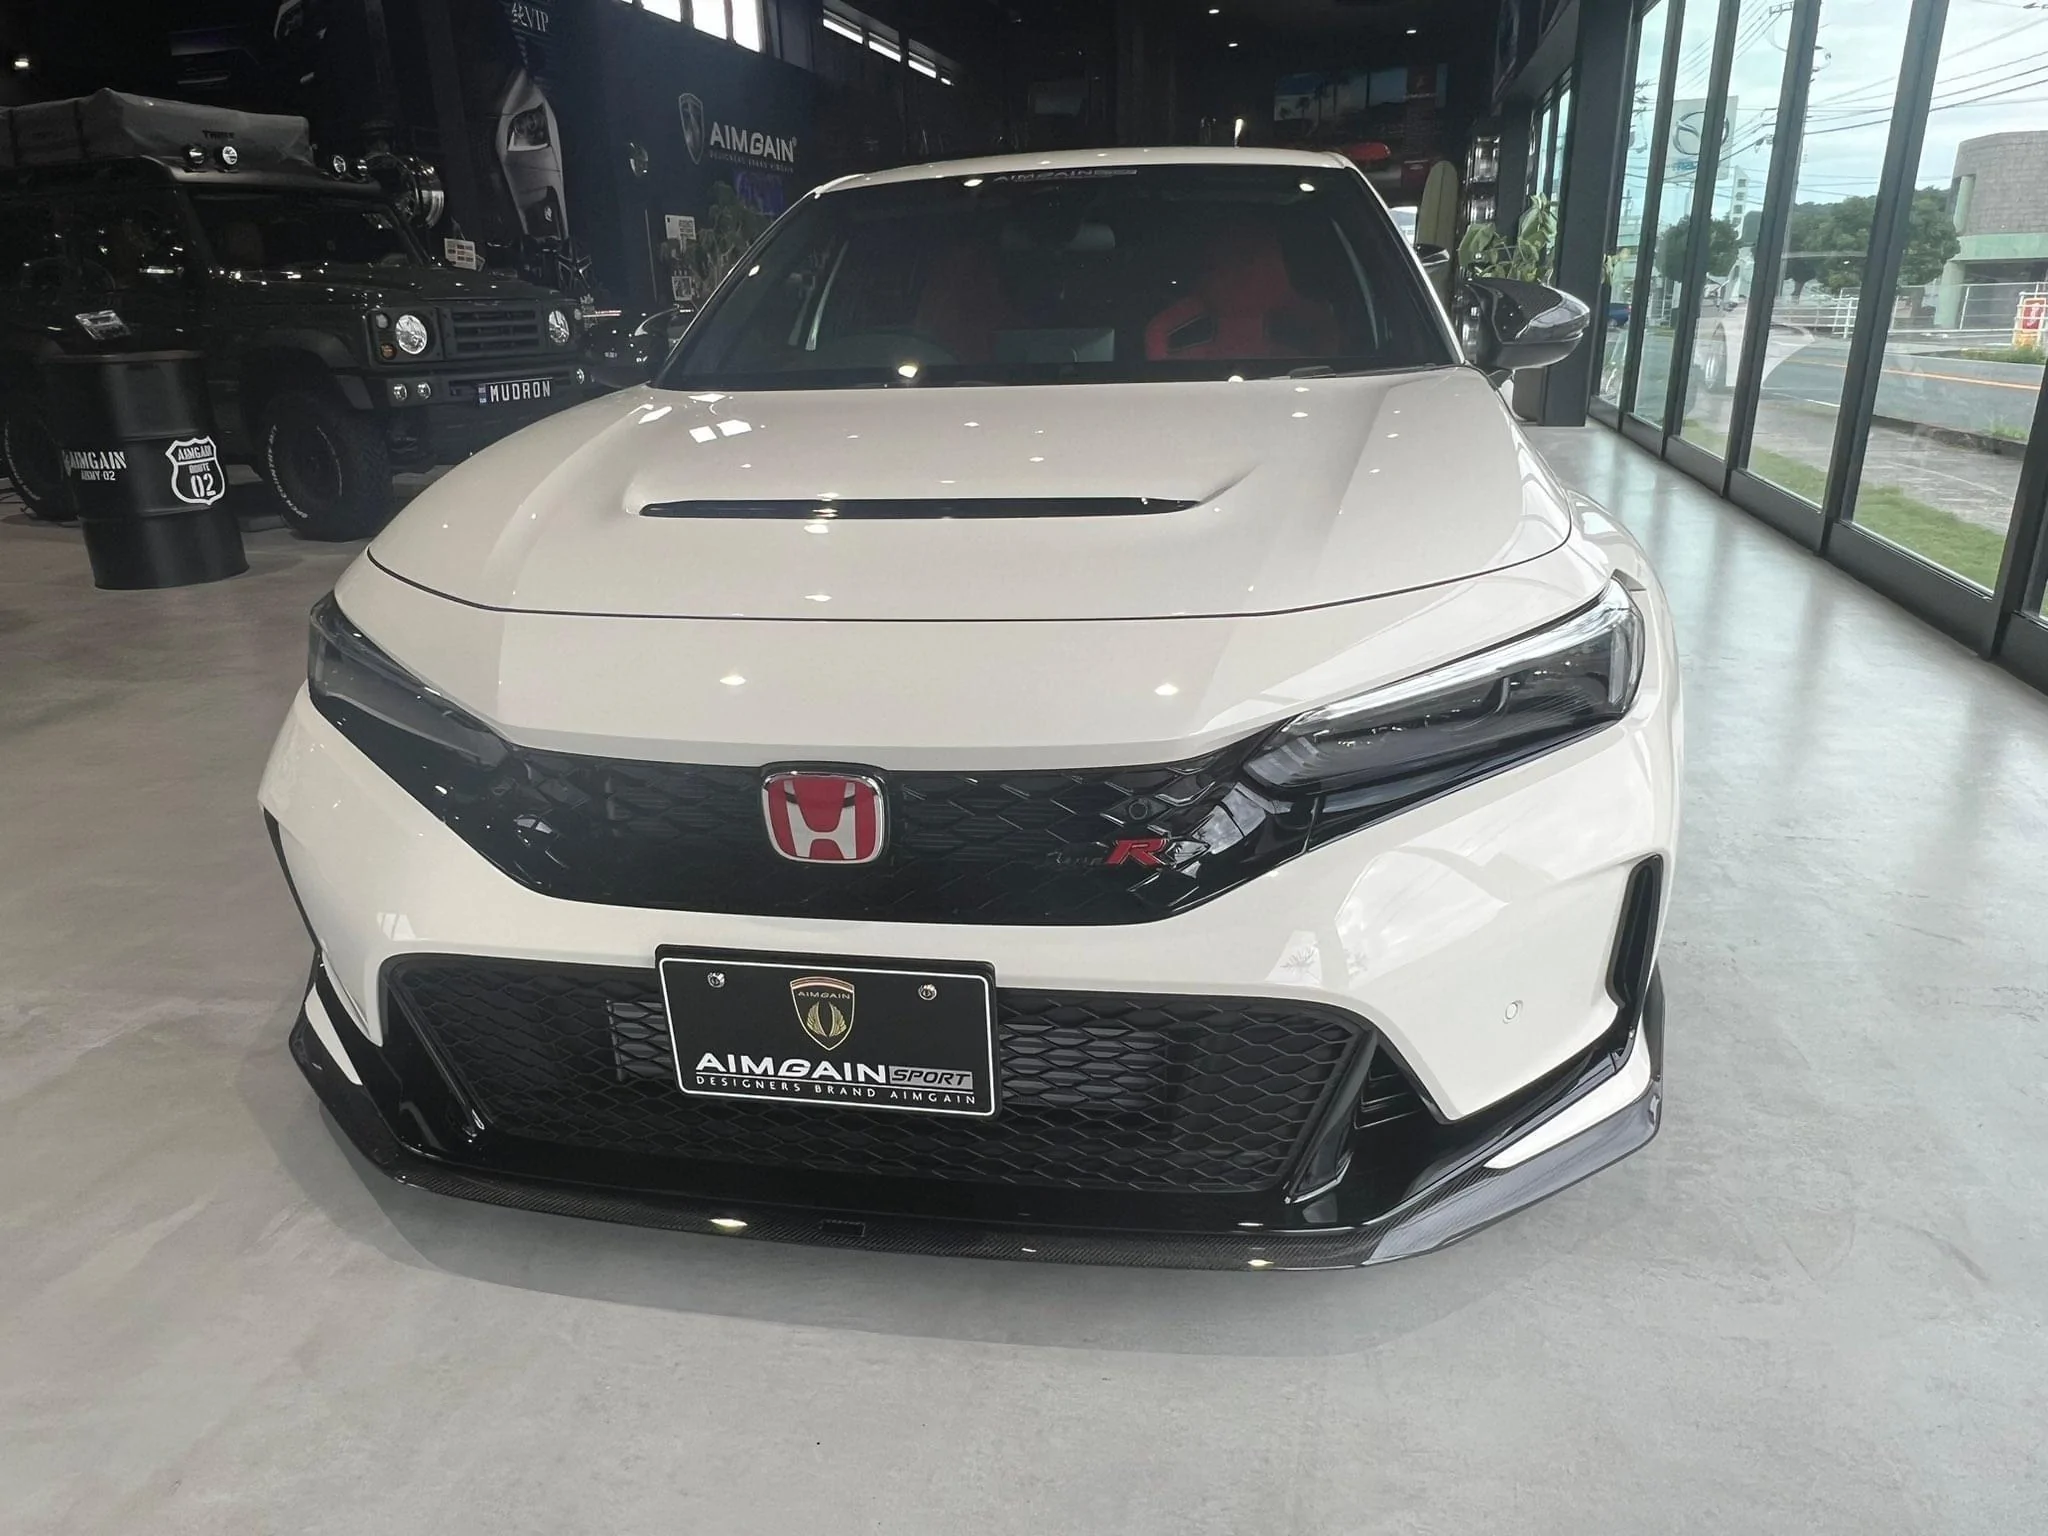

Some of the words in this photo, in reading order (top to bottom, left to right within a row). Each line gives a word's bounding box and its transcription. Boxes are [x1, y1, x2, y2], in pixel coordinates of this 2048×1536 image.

[490, 380, 551, 403] MUDRON
[69, 450, 127, 470] AIMGAIN
[176, 445, 213, 461] AIMGAIN
[190, 473, 217, 498] 02
[797, 991, 851, 1000] AIMGAIN
[695, 1052, 887, 1084] AIMGAIN
[891, 1068, 972, 1086] SPORT
[696, 1075, 802, 1093] DESIGNERS
[814, 1084, 876, 1098] BRAND
[890, 1090, 976, 1105] AIMGAIN
